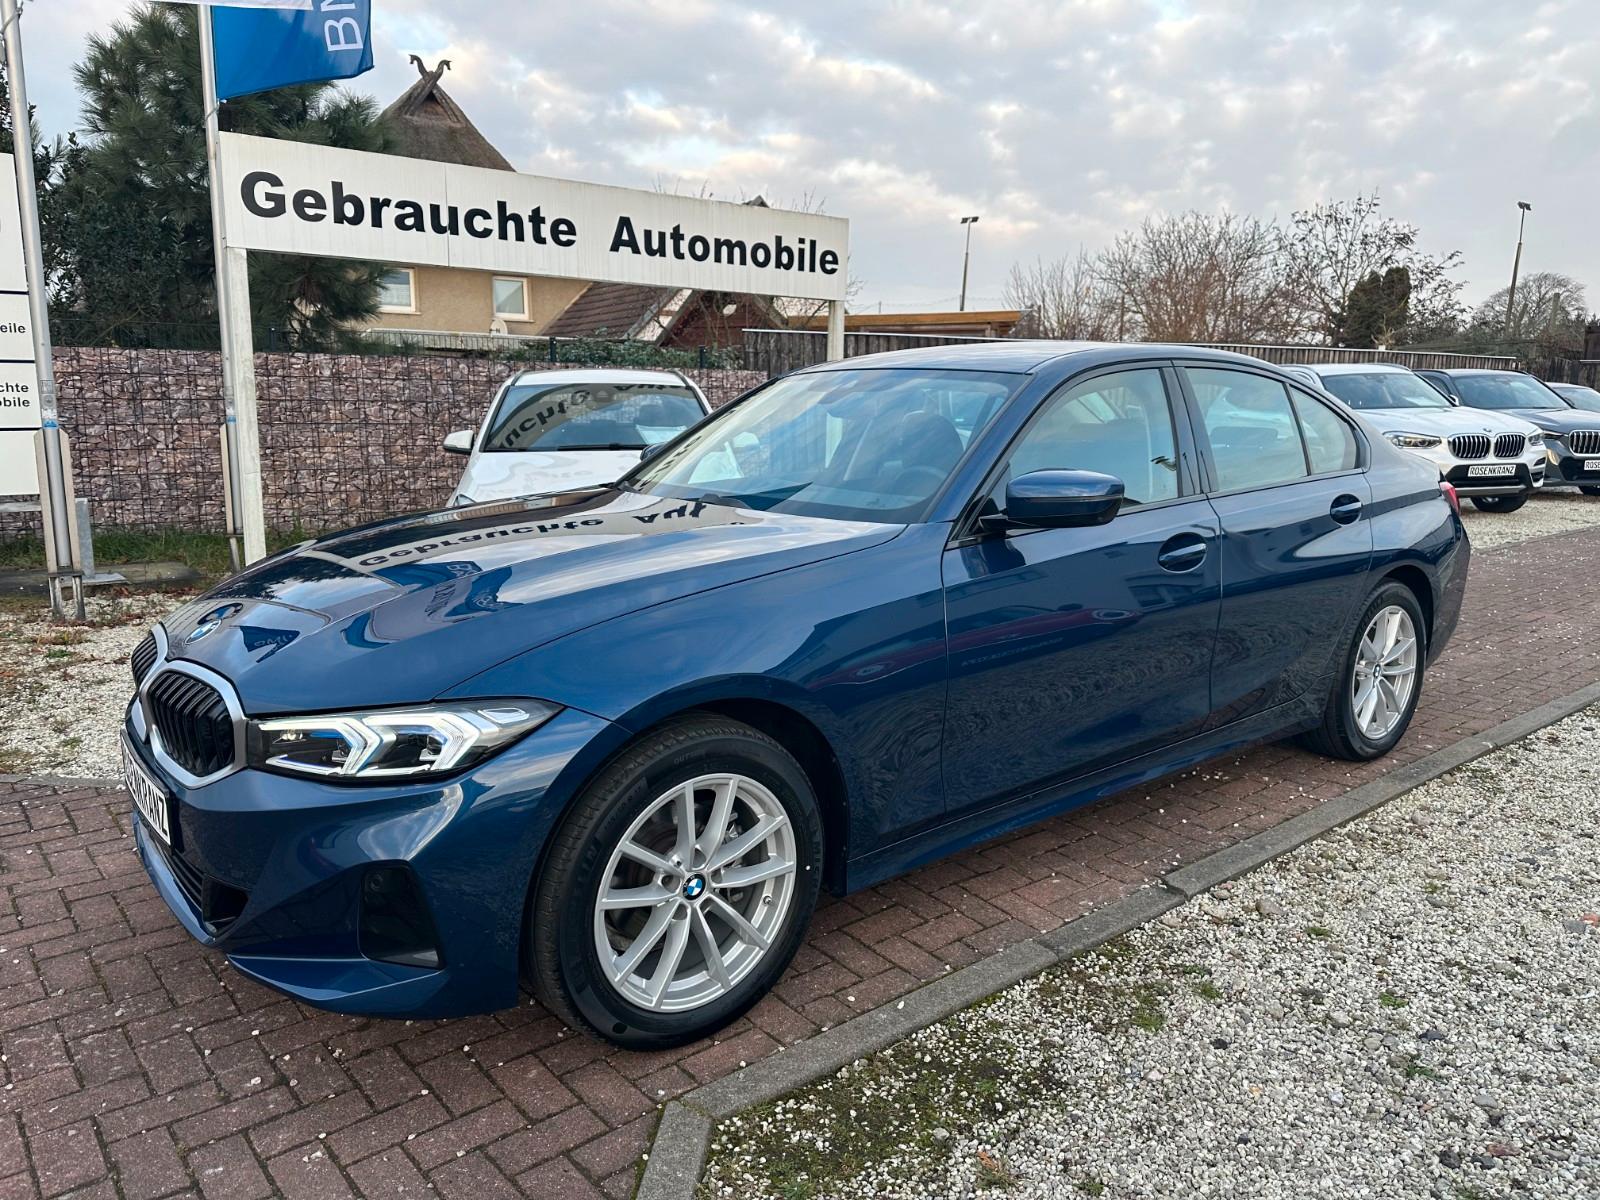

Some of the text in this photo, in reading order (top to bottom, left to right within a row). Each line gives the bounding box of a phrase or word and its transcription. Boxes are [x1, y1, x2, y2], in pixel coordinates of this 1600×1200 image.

[240, 171, 839, 275] Gebrauchte Automobile
[0, 397, 31, 407] bile
[1470, 466, 1514, 476] ROSENKRANZ
